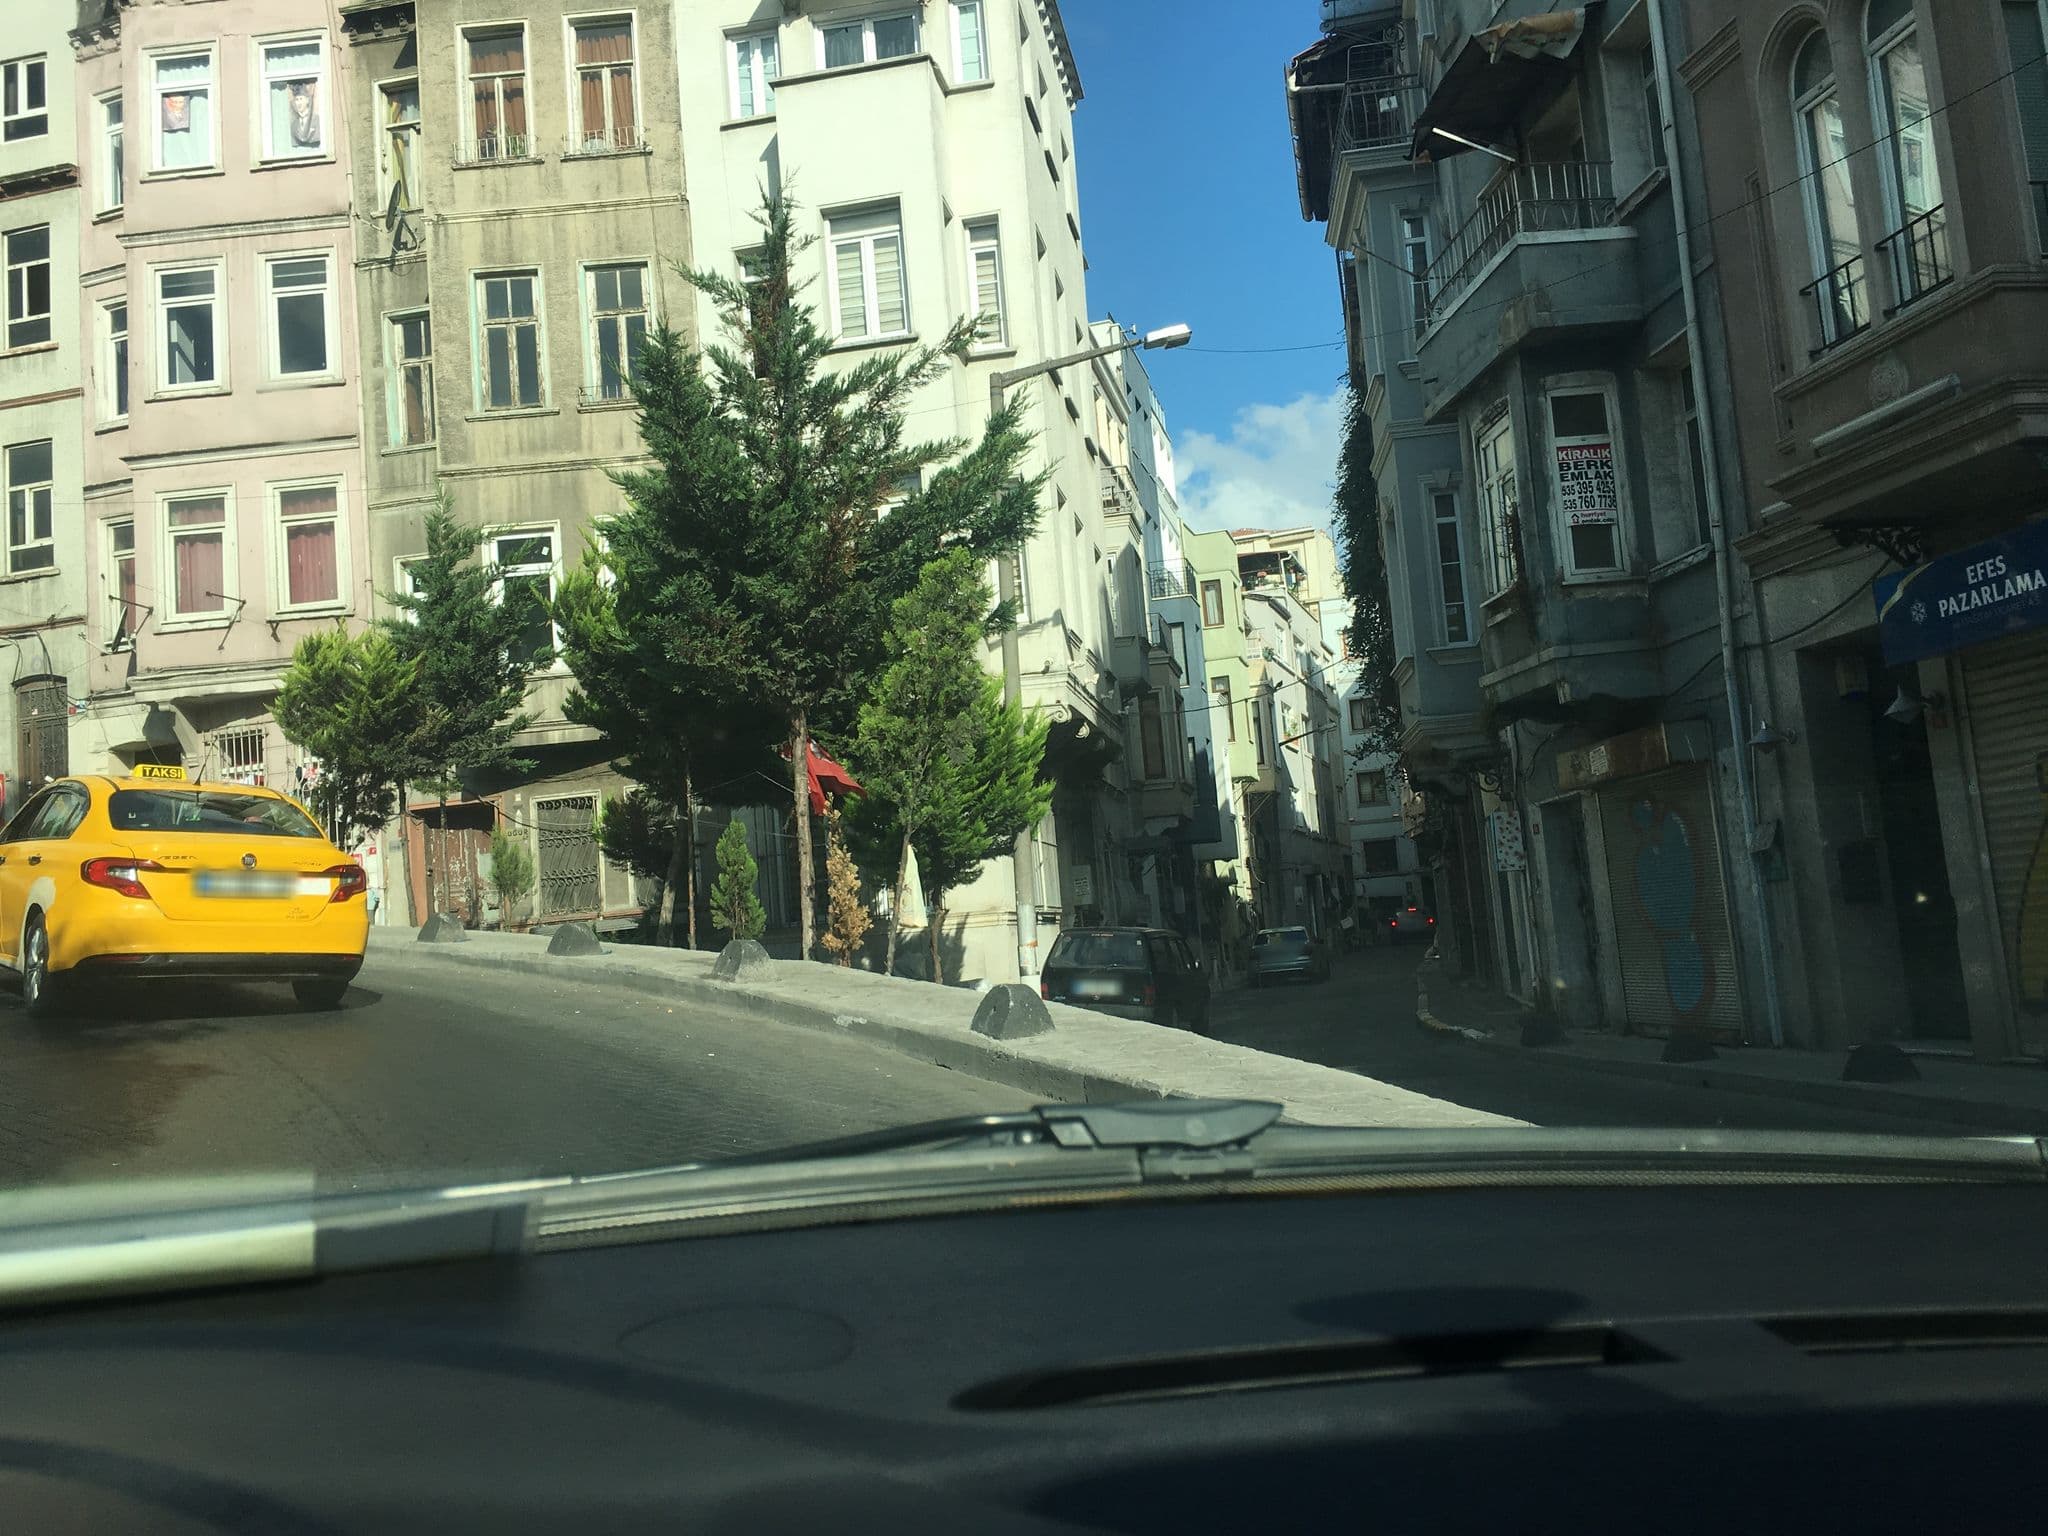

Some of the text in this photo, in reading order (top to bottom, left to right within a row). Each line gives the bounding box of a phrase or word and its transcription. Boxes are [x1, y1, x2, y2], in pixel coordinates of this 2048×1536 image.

[1558, 449, 1611, 461] KİRALIK
[1558, 460, 1613, 472] BERK
[1560, 471, 1614, 482] EMLAK
[1561, 485, 1575, 496] 535
[1577, 481, 1594, 494] 395
[1563, 499, 1577, 510] 535
[1578, 495, 1595, 509] 760
[1966, 555, 2007, 585] EFES
[1938, 569, 2048, 618] PAZARLAMA
